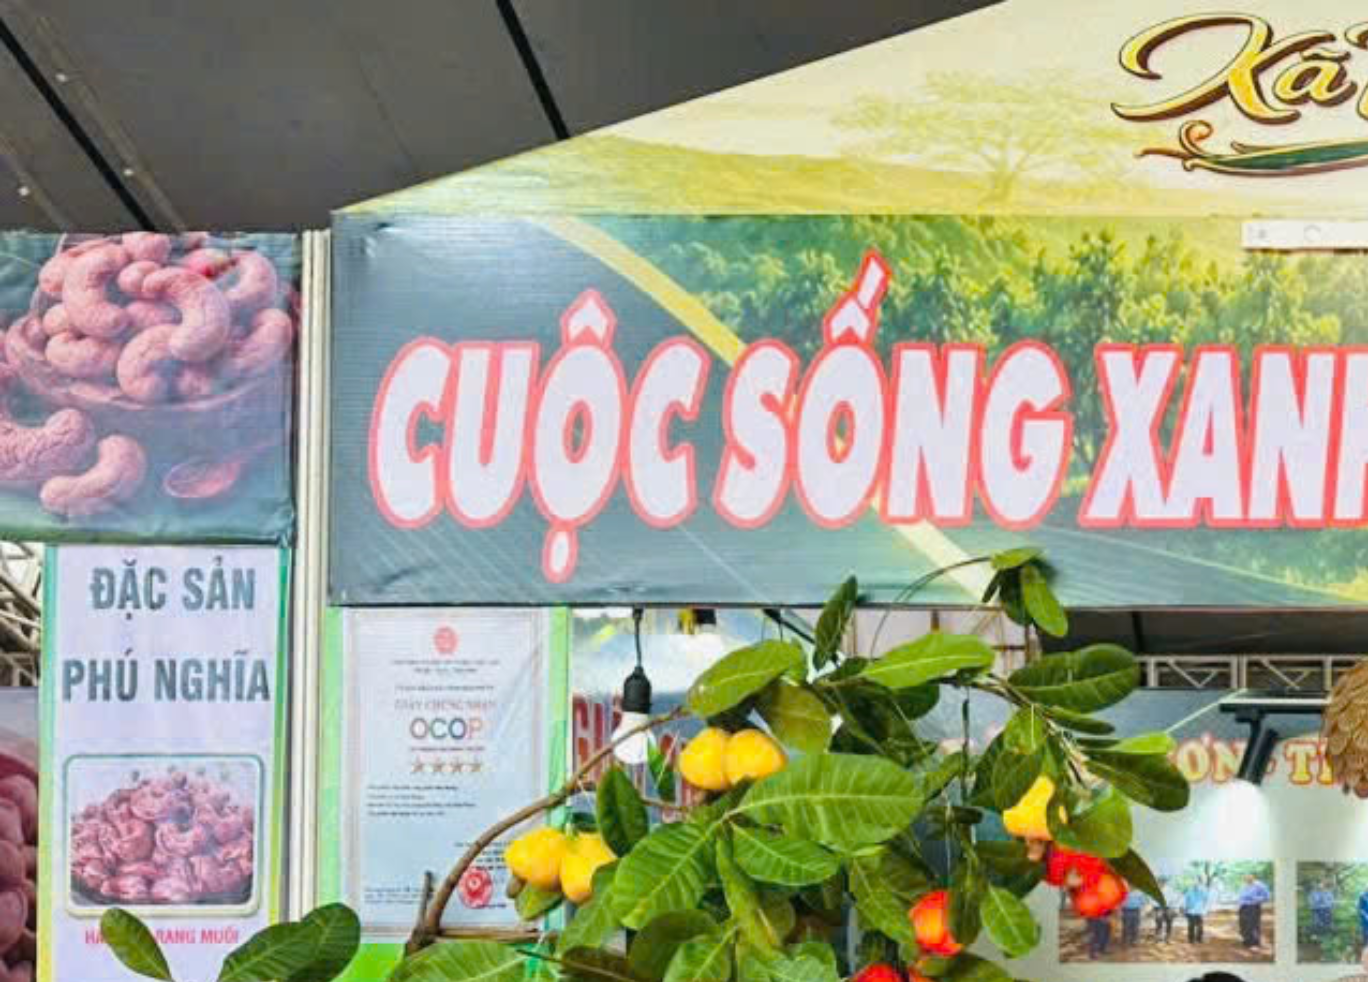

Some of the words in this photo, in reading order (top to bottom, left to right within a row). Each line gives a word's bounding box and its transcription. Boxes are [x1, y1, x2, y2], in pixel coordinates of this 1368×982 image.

[1111, 15, 1354, 126] Xã
[369, 288, 710, 584] CUỘC
[714, 248, 1073, 529] SỐNG
[90, 559, 167, 620] ĐẶC
[183, 555, 256, 610] SẢN
[63, 649, 138, 701] PHÚ
[155, 649, 270, 701] NGHĨA
[410, 717, 482, 740] OCOP
